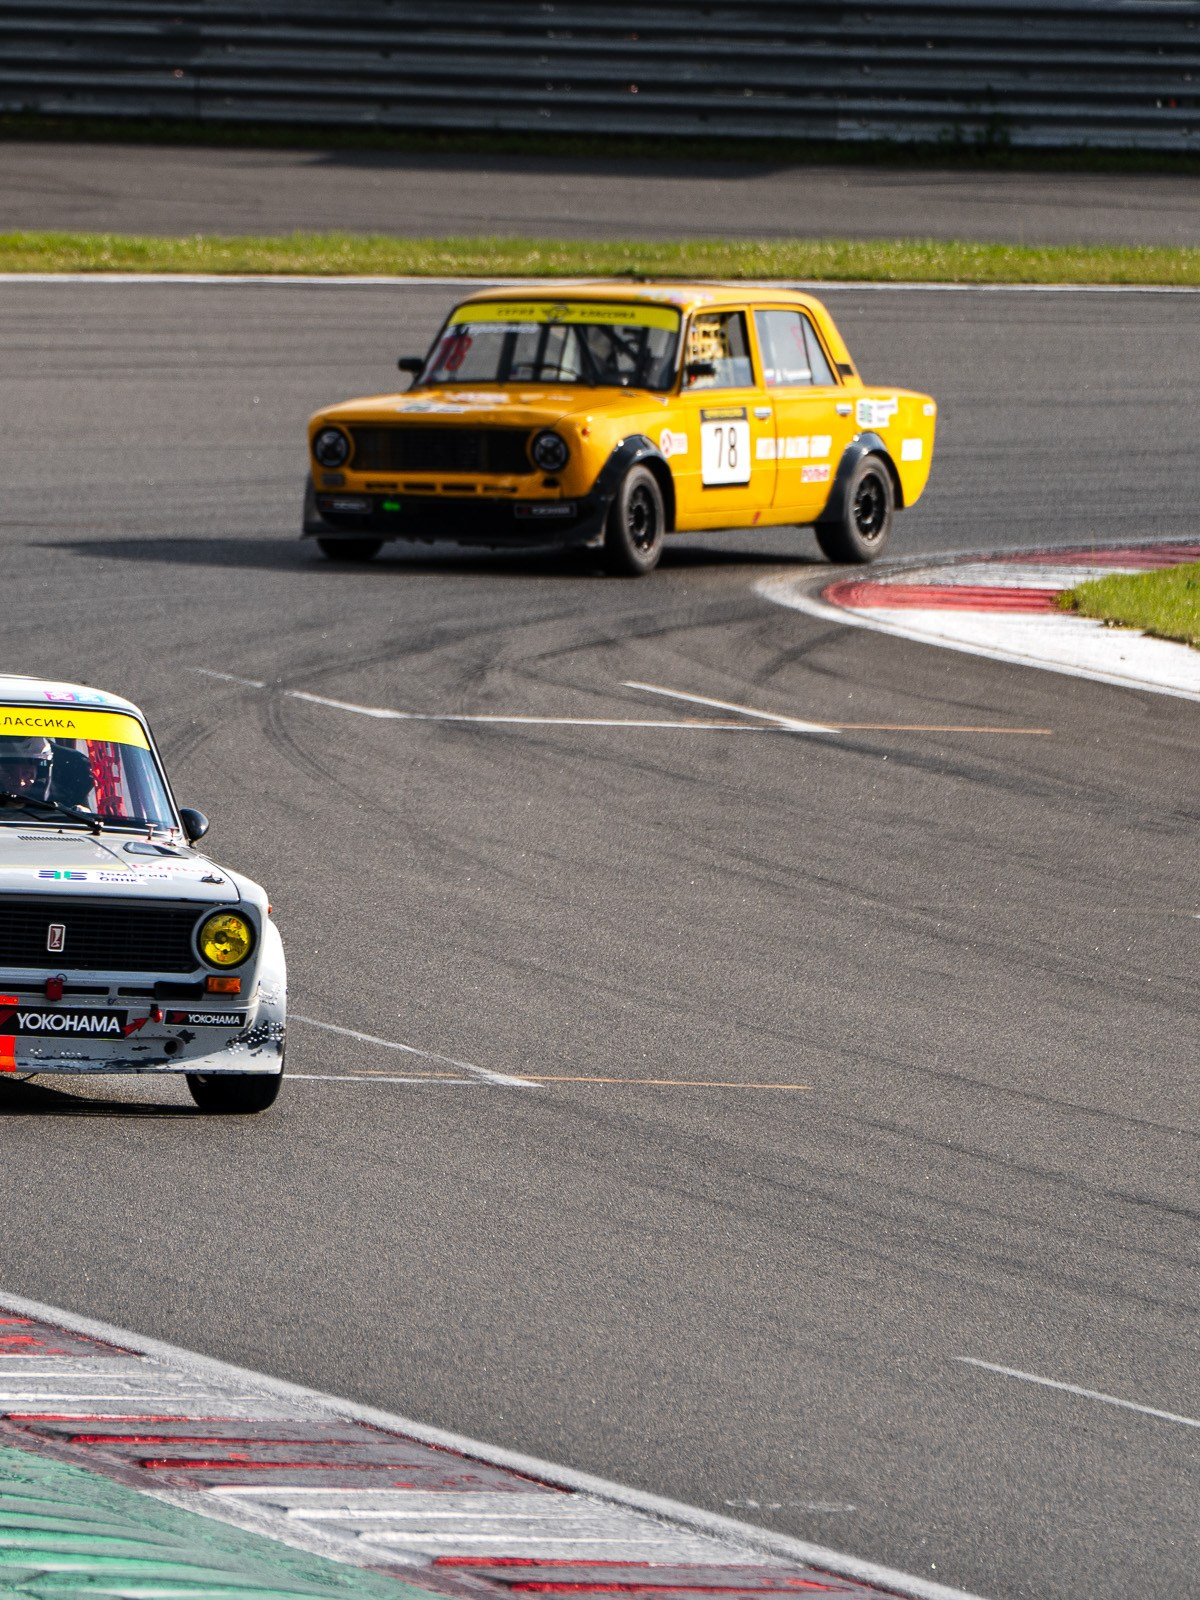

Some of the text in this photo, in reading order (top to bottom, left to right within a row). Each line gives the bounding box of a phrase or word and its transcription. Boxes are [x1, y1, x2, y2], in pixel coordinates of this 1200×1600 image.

[714, 427, 738, 469] 78
[16, 1011, 121, 1034] YOKOHAMA
[187, 1013, 241, 1025] YOKOHAMA
